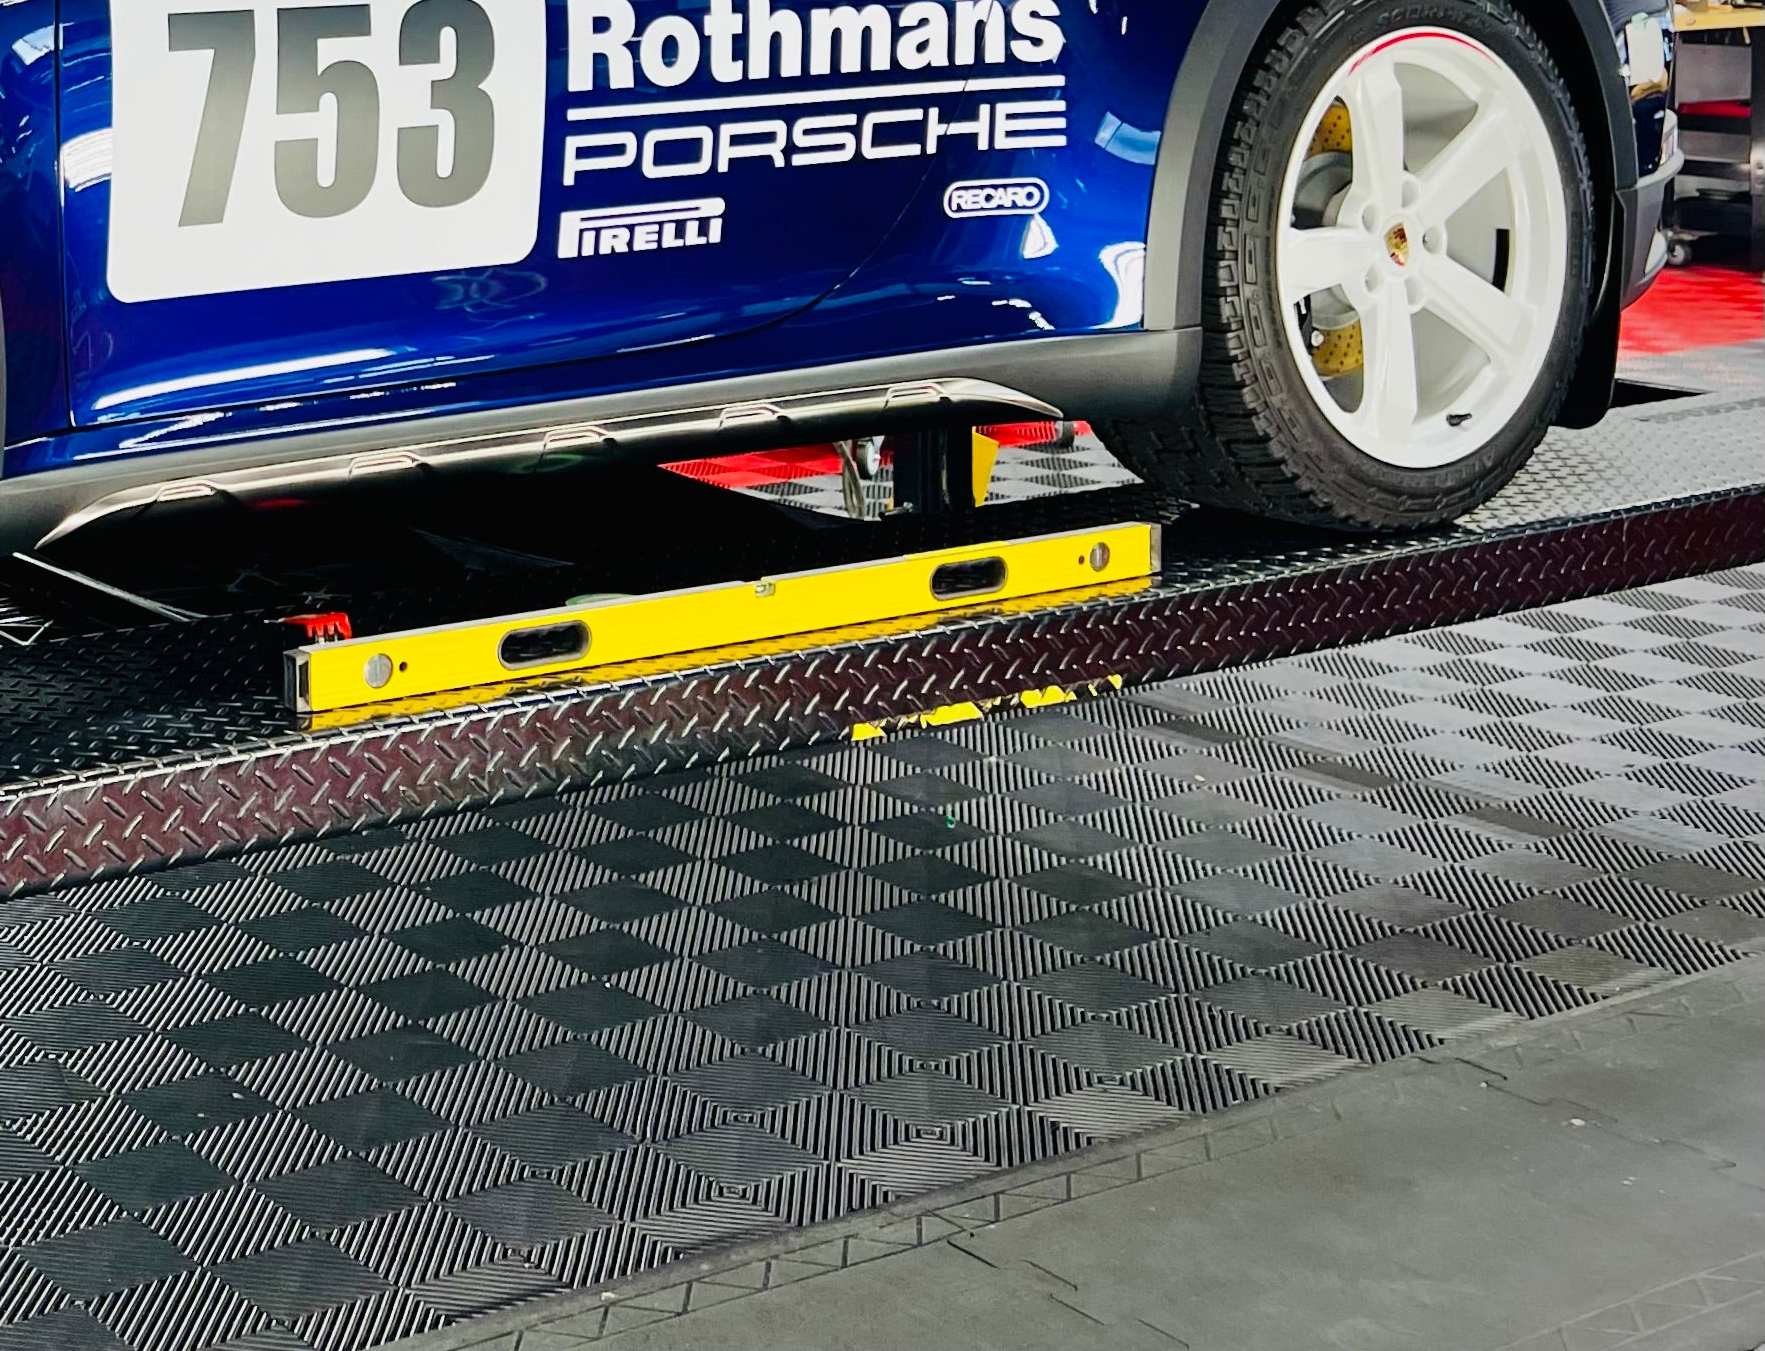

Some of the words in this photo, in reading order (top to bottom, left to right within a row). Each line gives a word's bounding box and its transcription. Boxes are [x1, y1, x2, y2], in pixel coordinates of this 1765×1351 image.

[562, 99, 1067, 187] PORSCHE
[557, 196, 726, 259] PIRELLI
[950, 186, 1040, 212] RECARO
